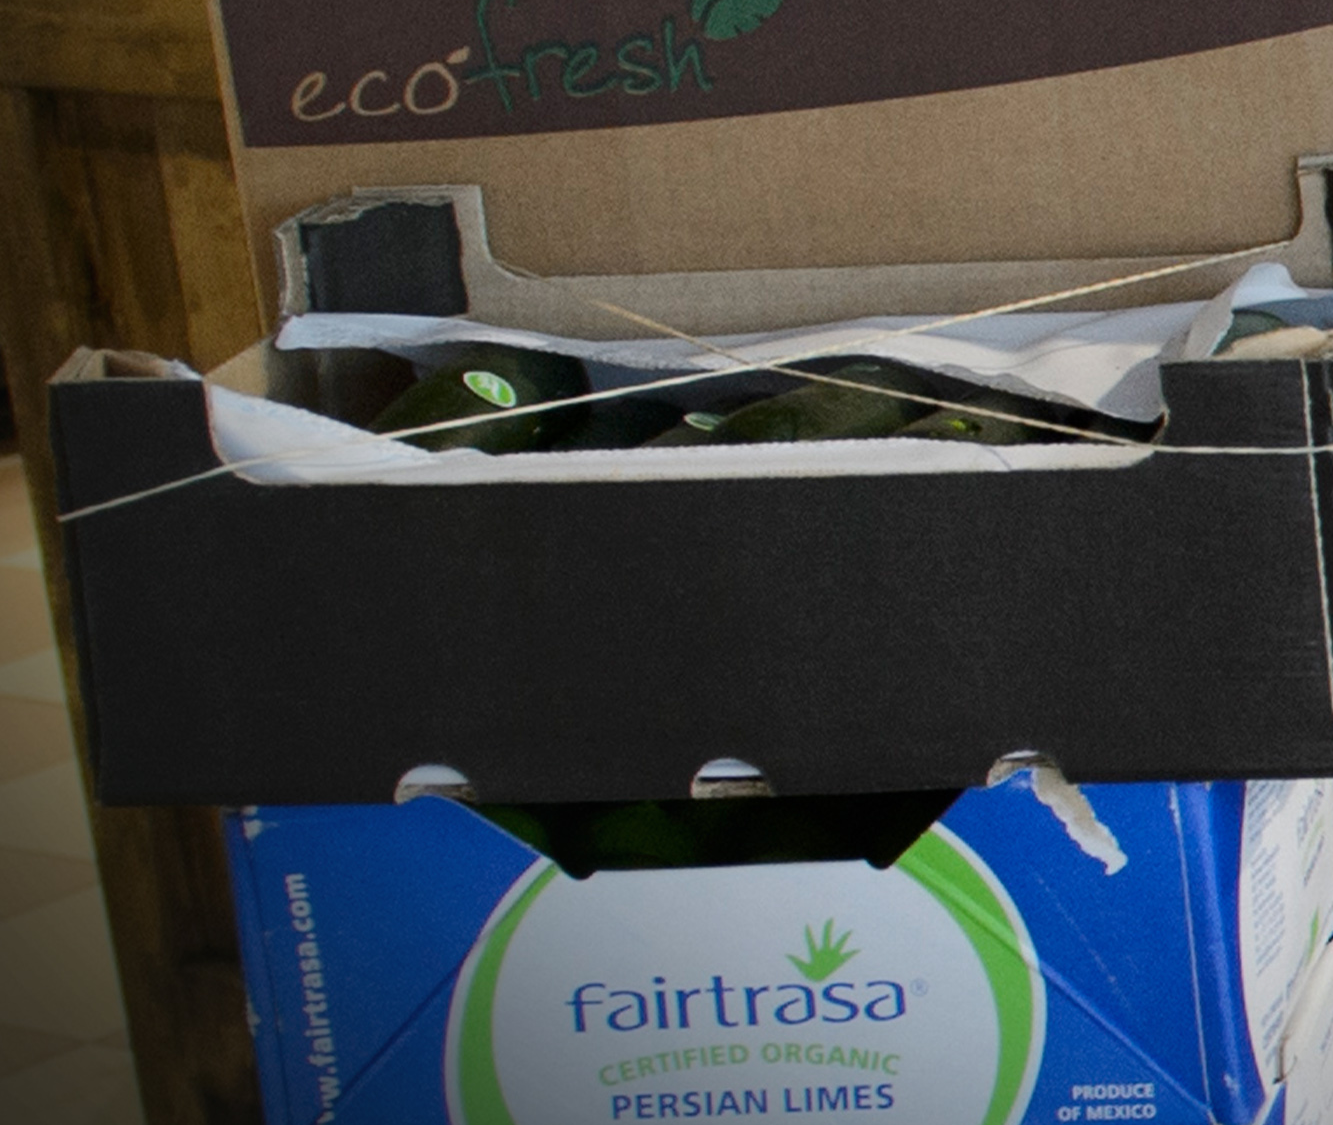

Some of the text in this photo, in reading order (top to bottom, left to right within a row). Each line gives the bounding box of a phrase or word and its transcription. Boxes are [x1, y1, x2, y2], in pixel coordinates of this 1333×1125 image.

[600, 1041, 901, 1088] CERTIFIED ORGANIC
[610, 1082, 896, 1121] PERSIAN LIMES
[1072, 1082, 1156, 1102] PRODUCE
[1058, 1101, 1157, 1122] OF MEXICO
